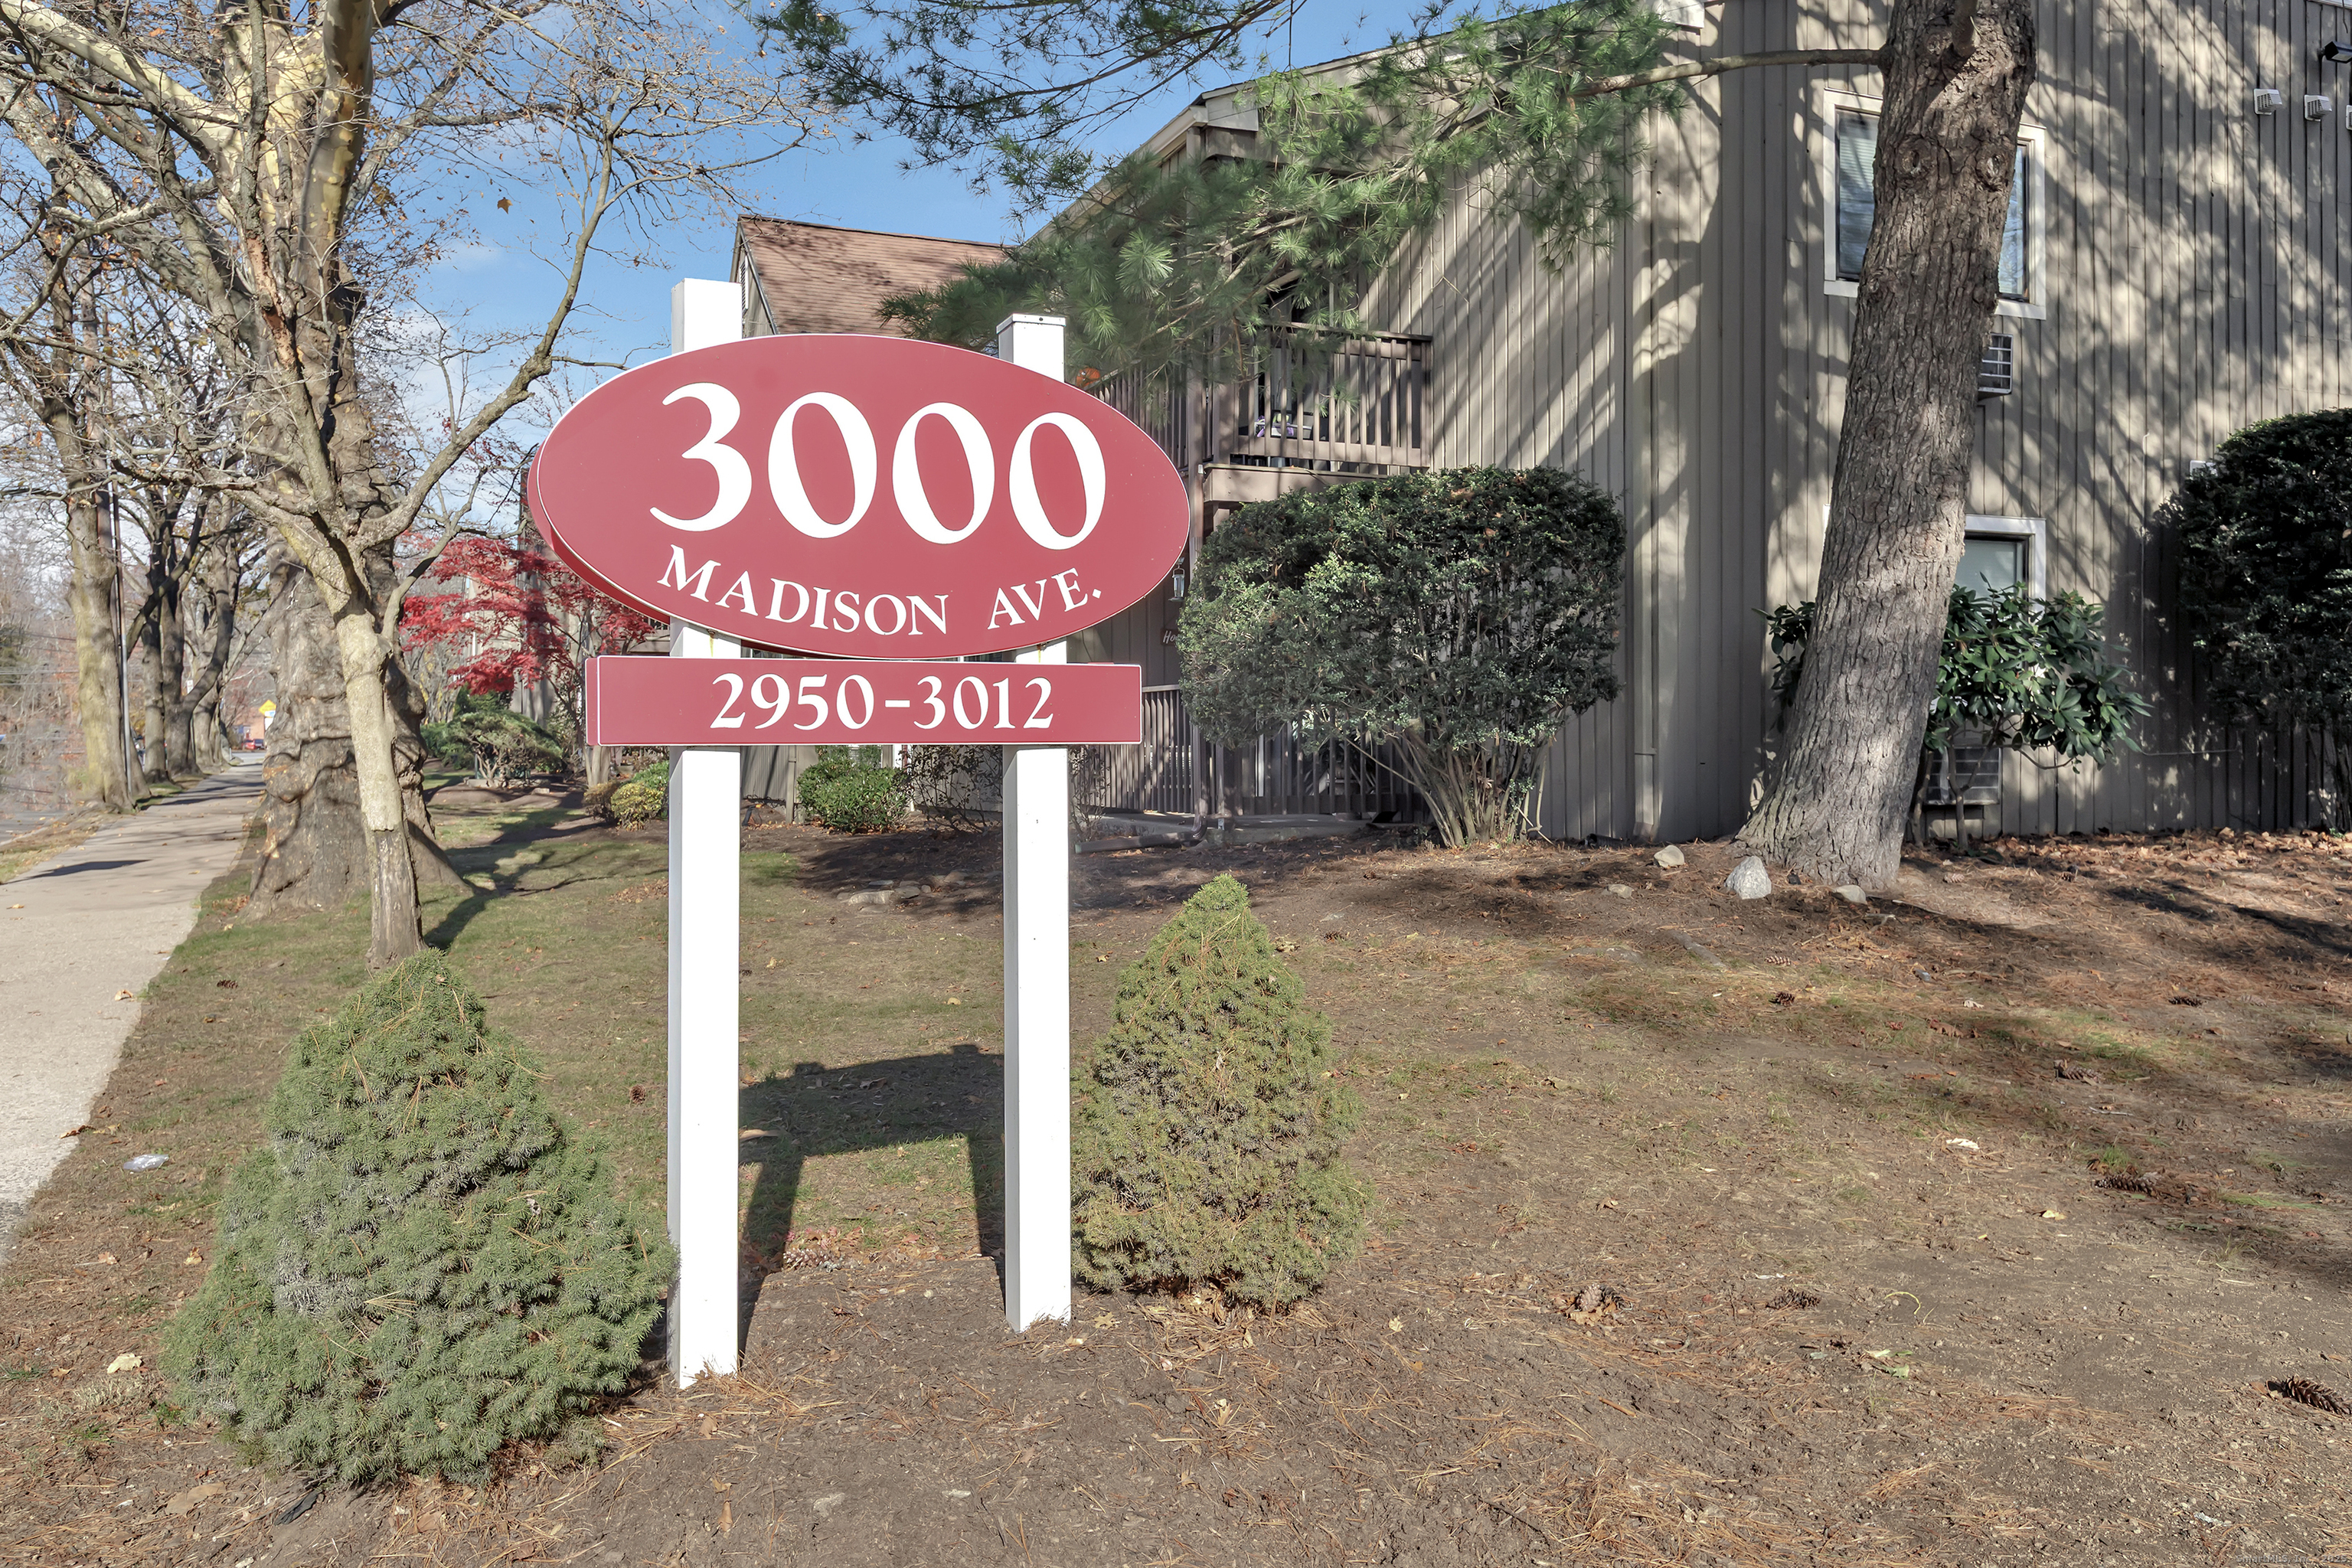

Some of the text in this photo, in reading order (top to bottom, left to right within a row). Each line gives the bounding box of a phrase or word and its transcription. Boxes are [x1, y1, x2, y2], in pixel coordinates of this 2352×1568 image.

[649, 382, 1106, 550] 3000
[656, 544, 1102, 636] MADISON AVE.
[1162, 630, 1178, 644] Ho
[710, 672, 1054, 731] 2950-3012
